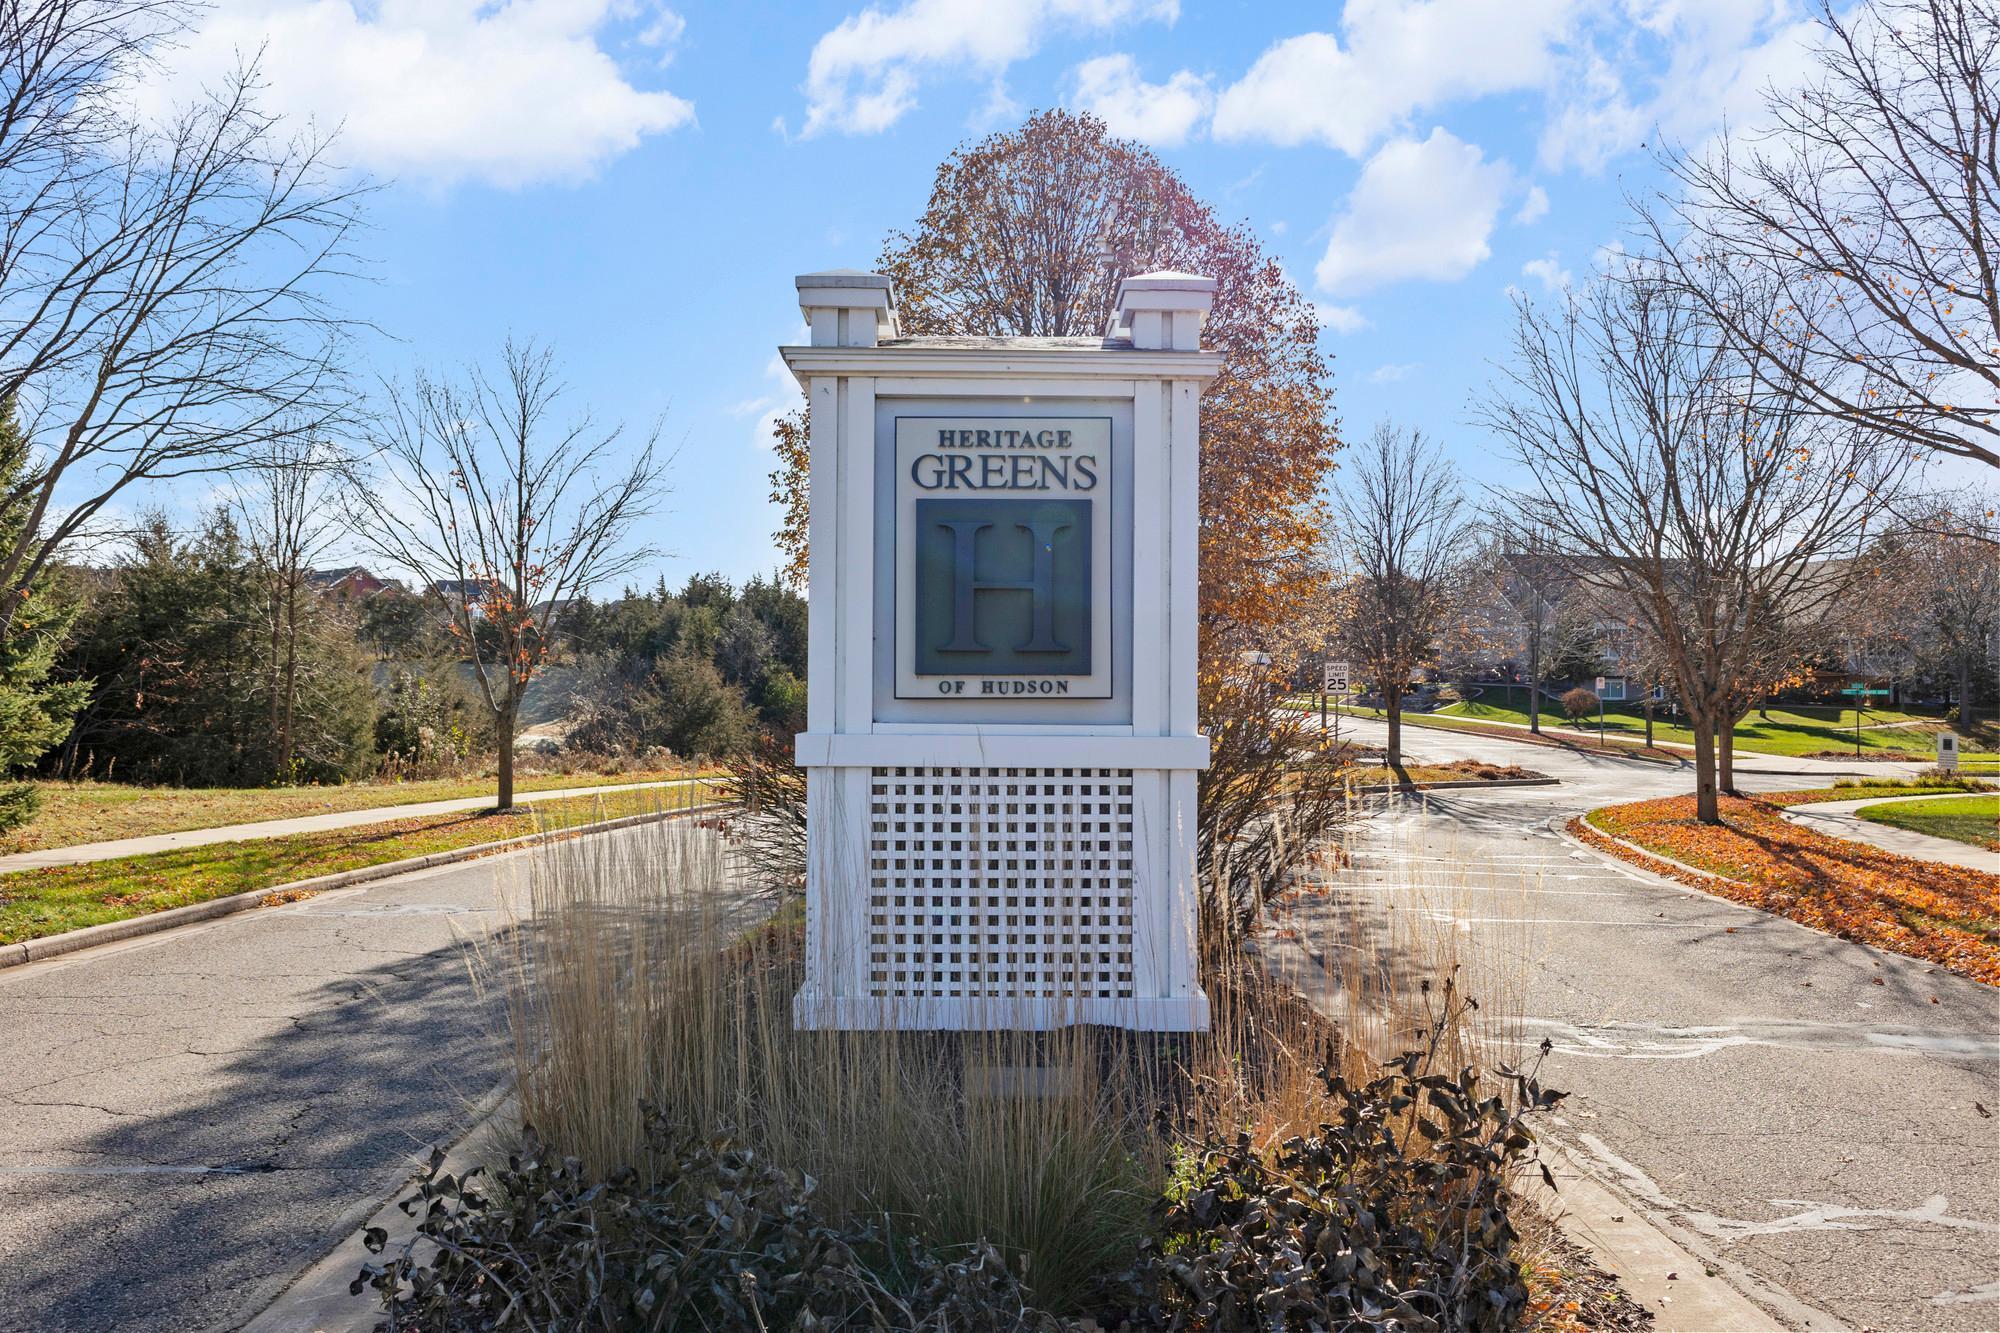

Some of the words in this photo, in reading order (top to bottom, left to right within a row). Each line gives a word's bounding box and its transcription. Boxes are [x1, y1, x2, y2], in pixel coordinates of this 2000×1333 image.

[937, 429, 1073, 449] HERITAGE
[910, 453, 1098, 491] GREENS
[935, 521, 1073, 654] H
[938, 680, 966, 695] OF
[981, 680, 1069, 695] HUDSON
[1327, 678, 1347, 690] 25
